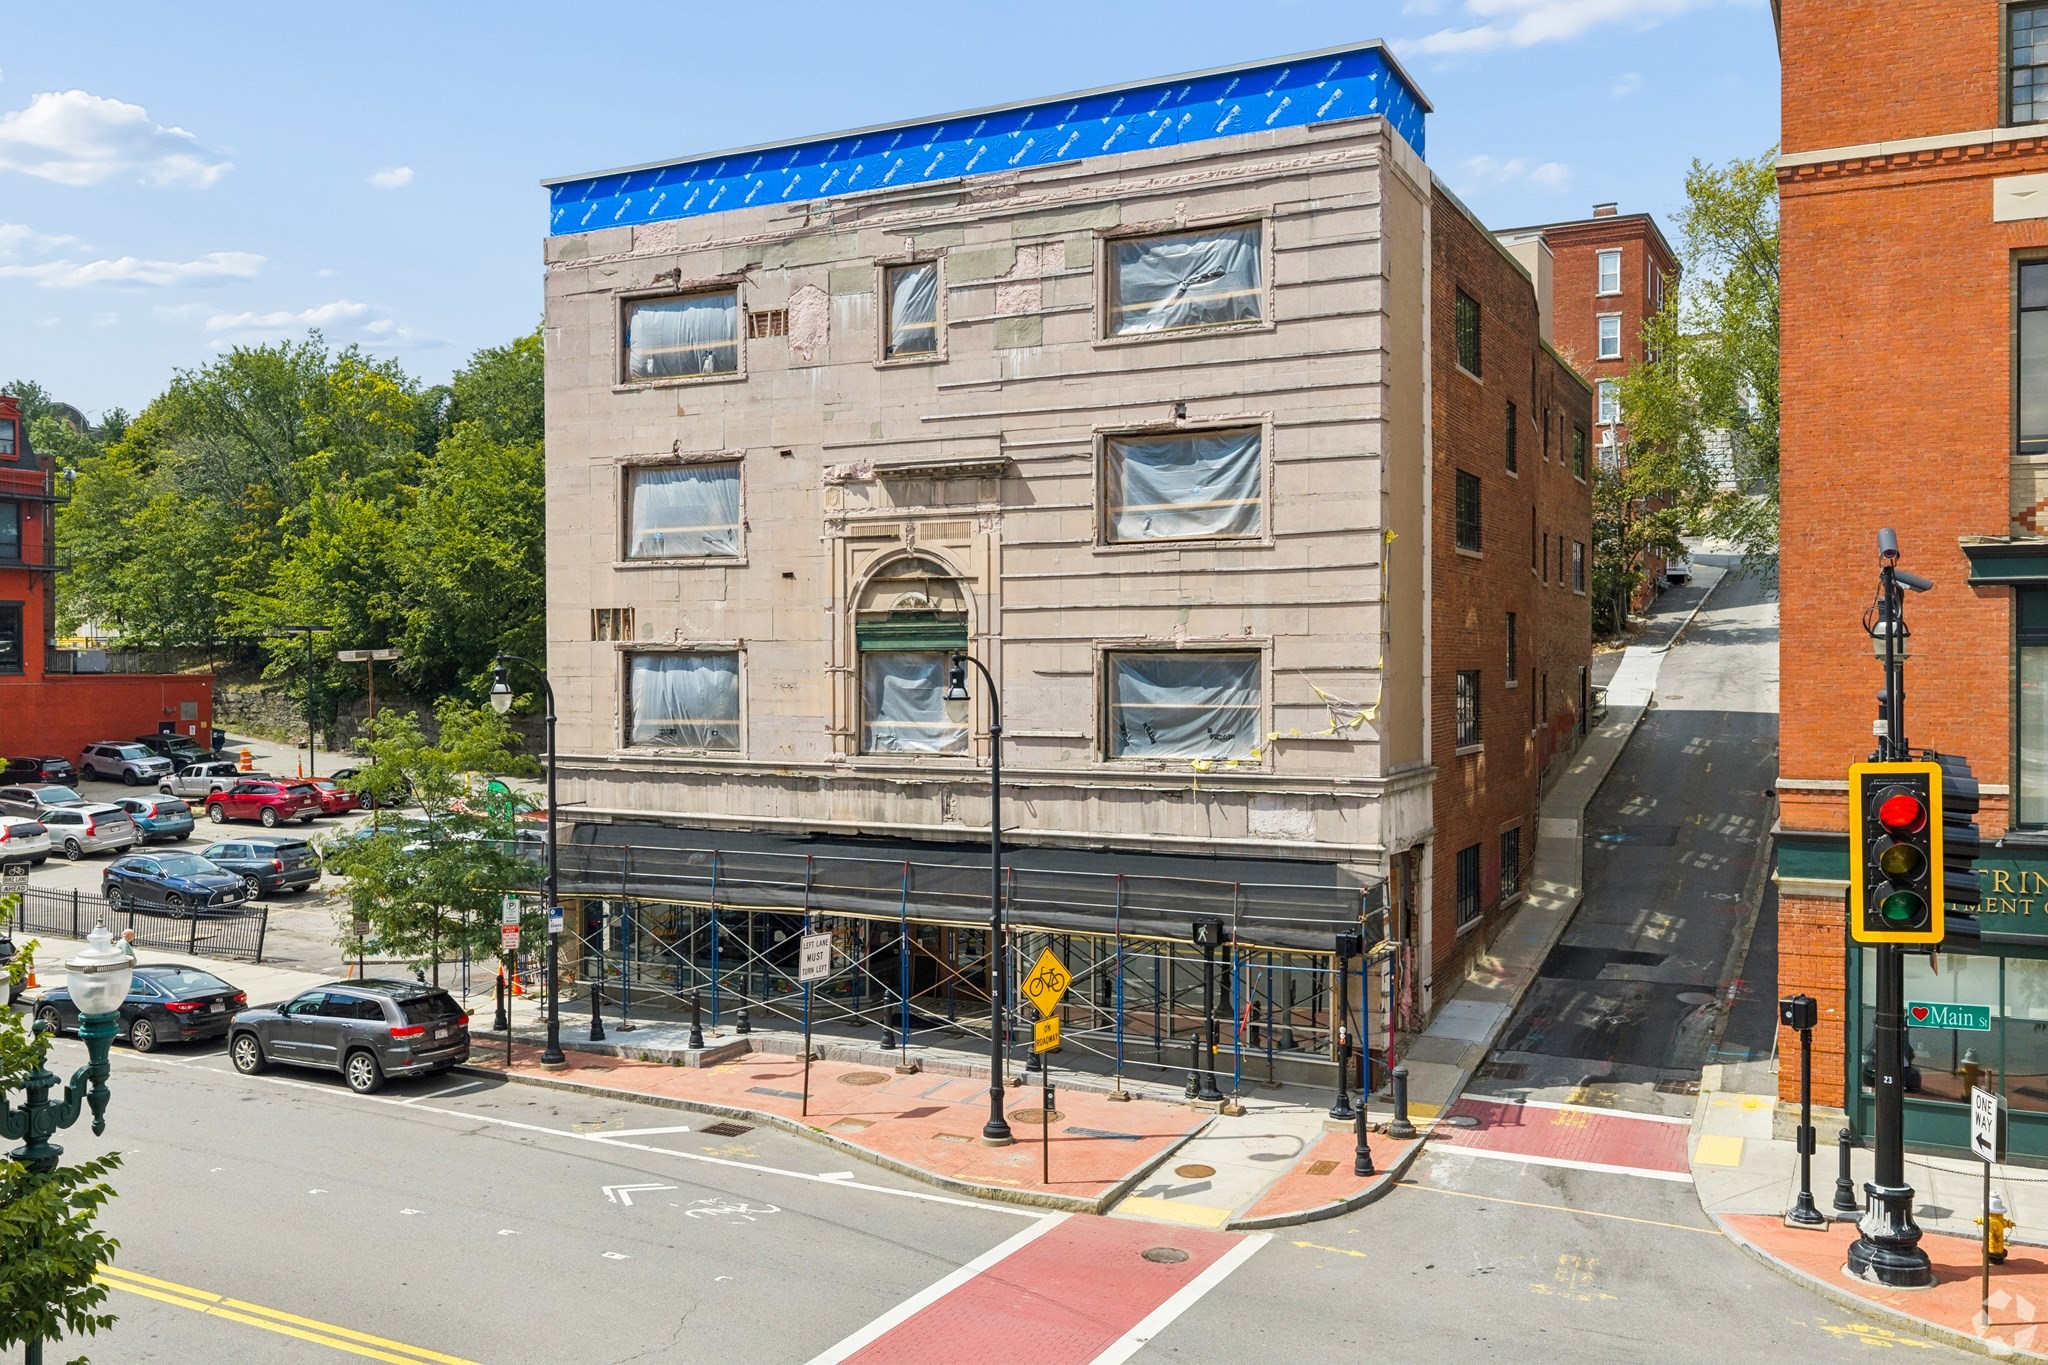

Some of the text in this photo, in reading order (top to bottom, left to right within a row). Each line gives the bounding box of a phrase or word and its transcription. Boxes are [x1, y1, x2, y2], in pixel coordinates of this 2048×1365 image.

[1979, 869, 2048, 895] RIN
[803, 939, 829, 950] LEFT LANE
[807, 951, 824, 963] MUST
[802, 964, 828, 976] TURN LEFT
[1930, 1005, 1988, 1028] Main St
[1043, 1025, 1051, 1033] ON
[1036, 1033, 1059, 1047] ROADWAY
[1883, 1075, 1893, 1084] 23
[1976, 1094, 1993, 1116] ONE
[1975, 1111, 1993, 1133] WAY
